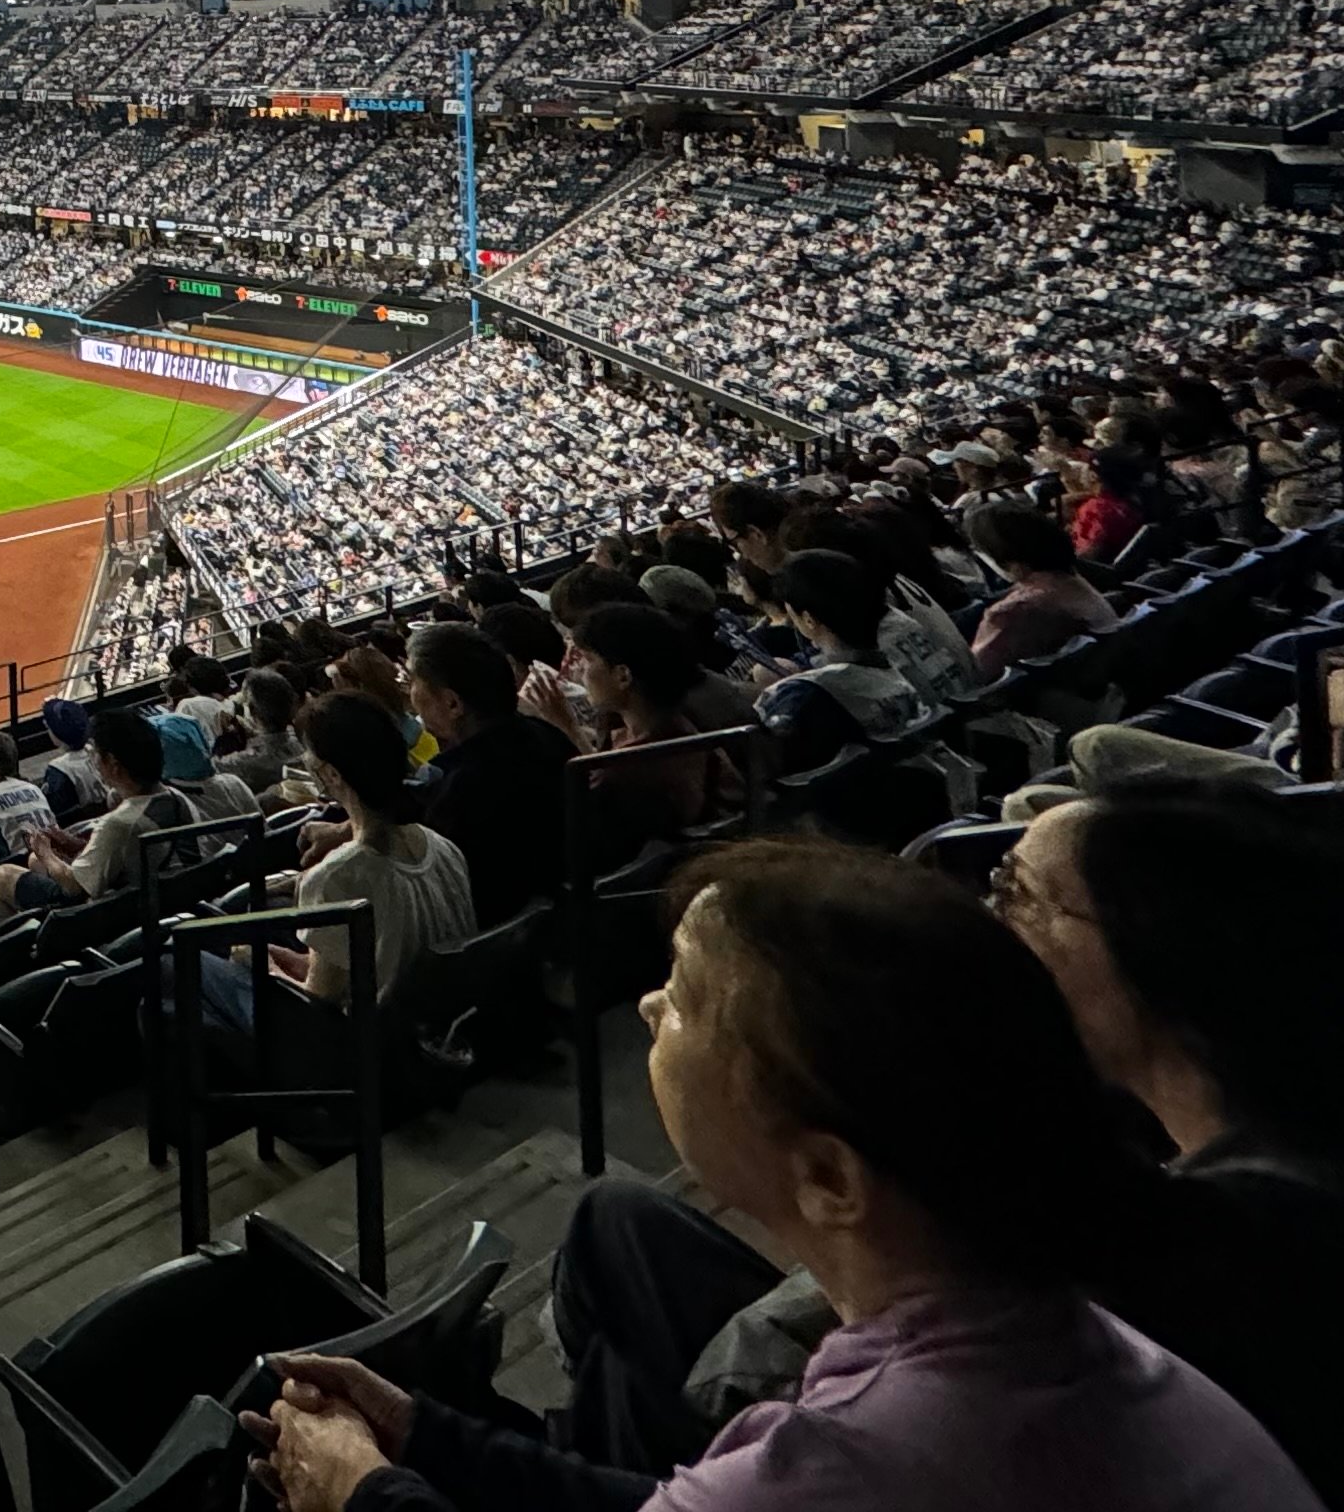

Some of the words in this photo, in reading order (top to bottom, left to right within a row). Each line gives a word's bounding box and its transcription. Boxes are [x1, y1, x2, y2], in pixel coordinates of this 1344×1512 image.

[389, 99, 425, 112] CAFE
[97, 346, 113, 362] 45
[121, 346, 157, 374] DREW
[162, 352, 231, 389] VERHAGEN
